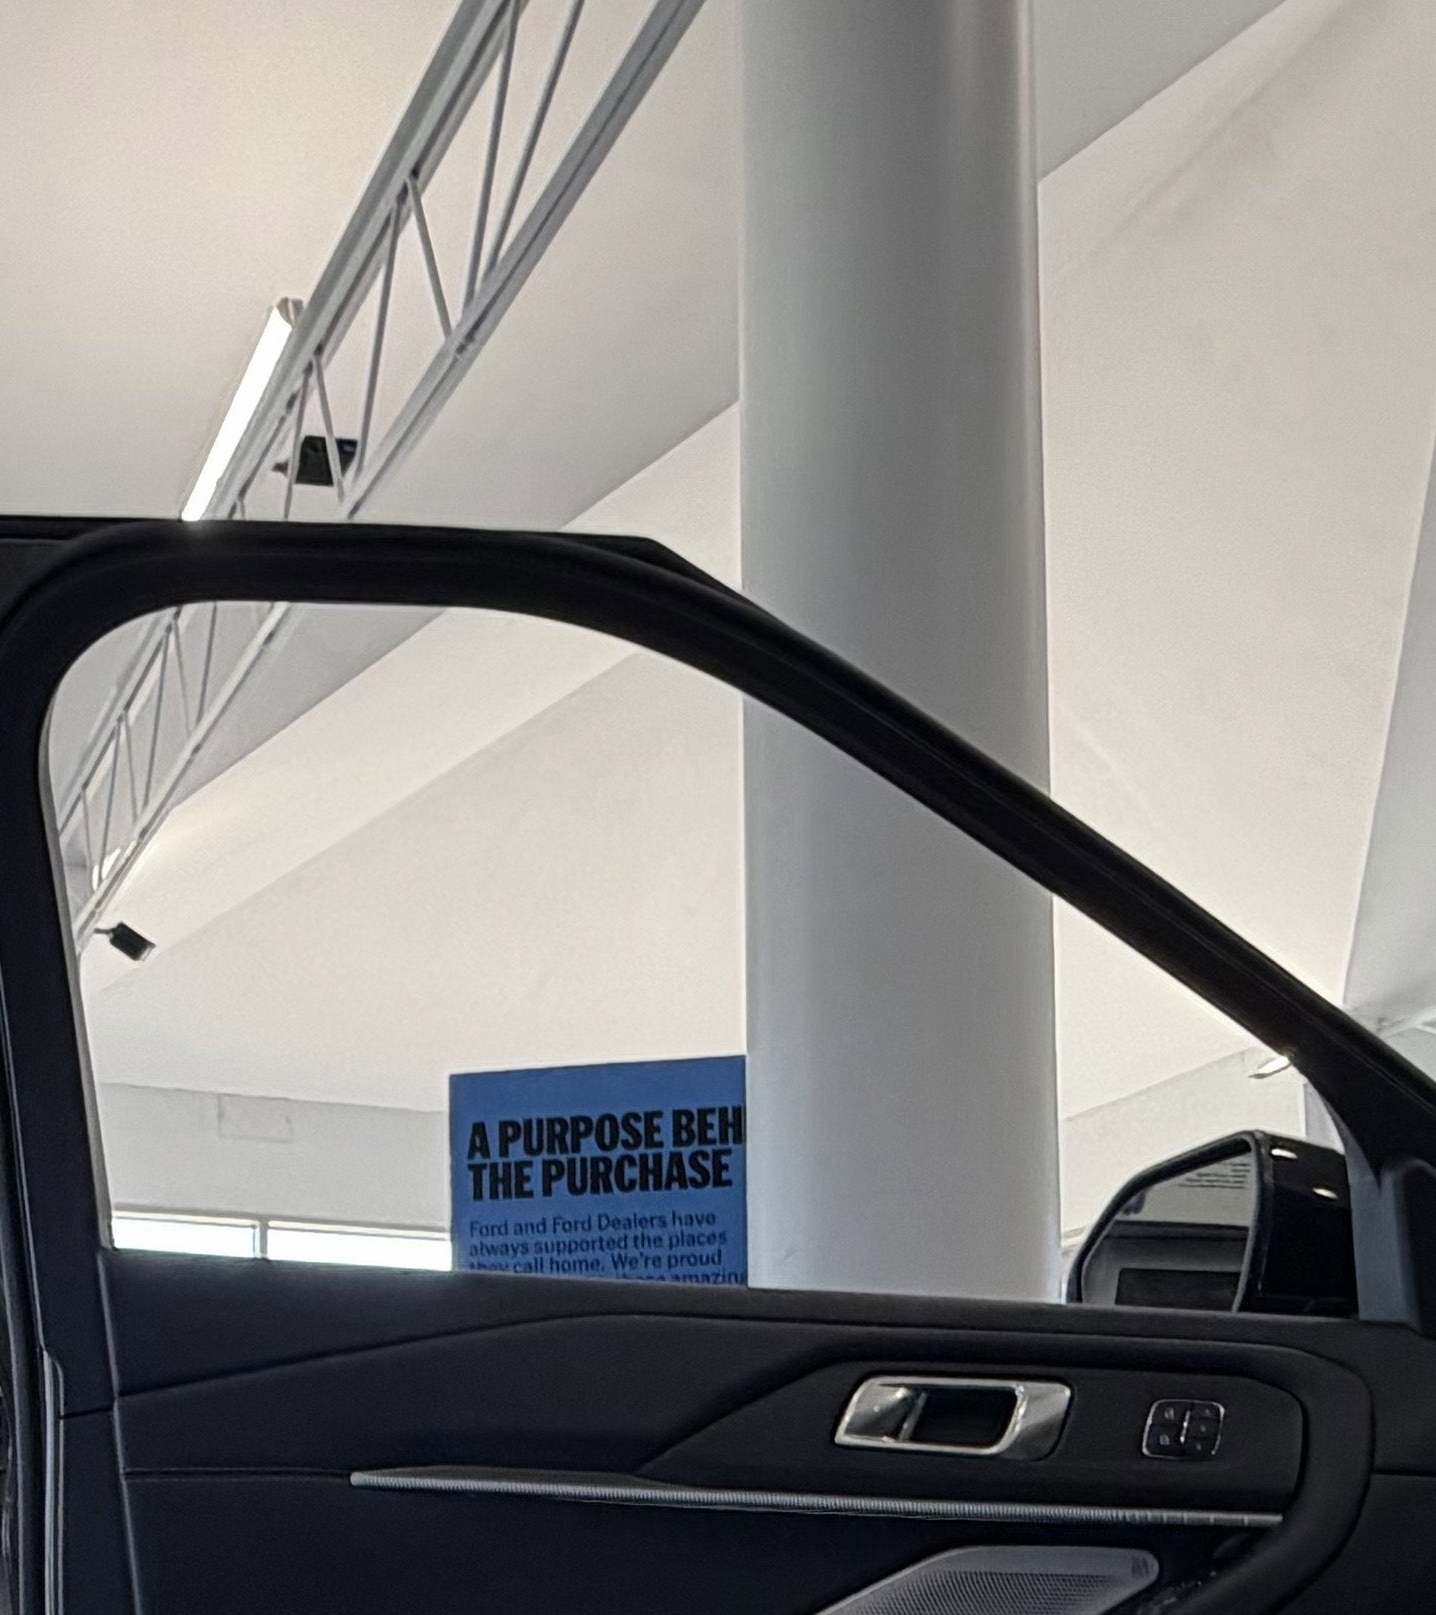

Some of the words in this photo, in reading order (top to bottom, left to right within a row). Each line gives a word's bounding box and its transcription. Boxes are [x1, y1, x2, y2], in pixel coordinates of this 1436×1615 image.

[467, 1121, 491, 1160] A
[497, 1110, 665, 1159] PURPOSE
[467, 1160, 535, 1201] THE
[541, 1149, 734, 1198] PURCHASE
[469, 1219, 509, 1238] Ford
[513, 1217, 547, 1236] and
[552, 1214, 593, 1235] Ford
[597, 1212, 667, 1232] Dealers
[671, 1209, 716, 1227] have
[469, 1238, 530, 1260] always
[533, 1233, 629, 1257] supported
[633, 1231, 664, 1249] the
[668, 1229, 728, 1254] places
[513, 1256, 545, 1274] call
[549, 1254, 606, 1273] home.
[610, 1251, 663, 1271] We're
[666, 1247, 723, 1272] proud
